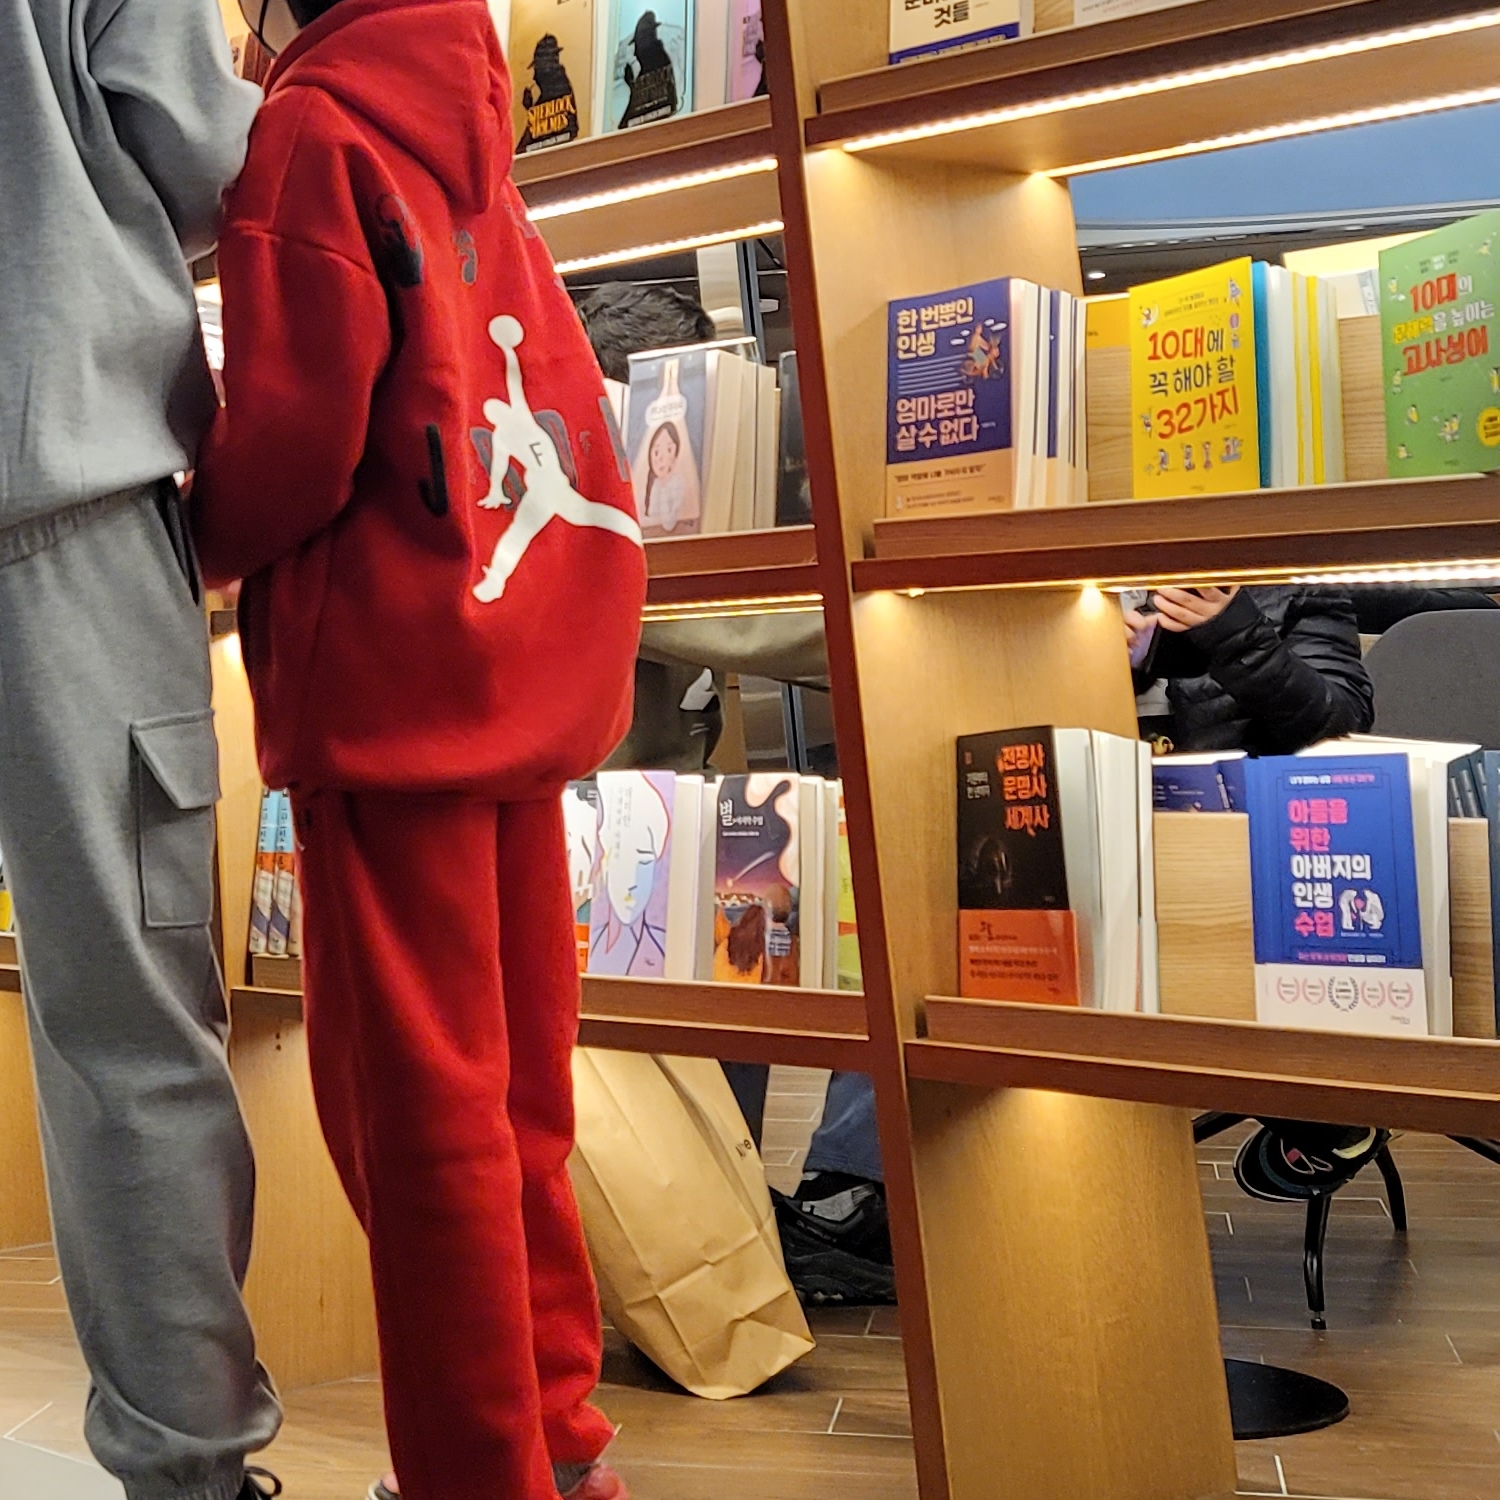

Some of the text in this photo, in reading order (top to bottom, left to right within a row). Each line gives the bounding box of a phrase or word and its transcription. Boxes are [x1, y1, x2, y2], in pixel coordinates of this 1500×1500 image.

[934, 0, 970, 28] 것들
[528, 95, 576, 121] SHERLOCK
[1409, 272, 1473, 313] 10대의
[897, 297, 974, 334] 한 번뿐인
[1451, 300, 1495, 328] 높이는
[897, 331, 936, 360] 인생
[1147, 326, 1225, 361] 10대에
[1402, 325, 1489, 376] 고사성어
[1150, 354, 1236, 397] 꼭 해야 할
[896, 388, 976, 424] 엄마로만
[1156, 384, 1239, 439] 32가지
[939, 414, 980, 447] 없다
[1003, 773, 1048, 800] 문명사
[1005, 804, 1051, 836] 세계사
[1287, 798, 1348, 825] 아들을
[1289, 826, 1331, 852] 위한
[1290, 853, 1373, 881] 아버지의
[1291, 881, 1335, 910] 인생
[1294, 911, 1335, 938] 수업
